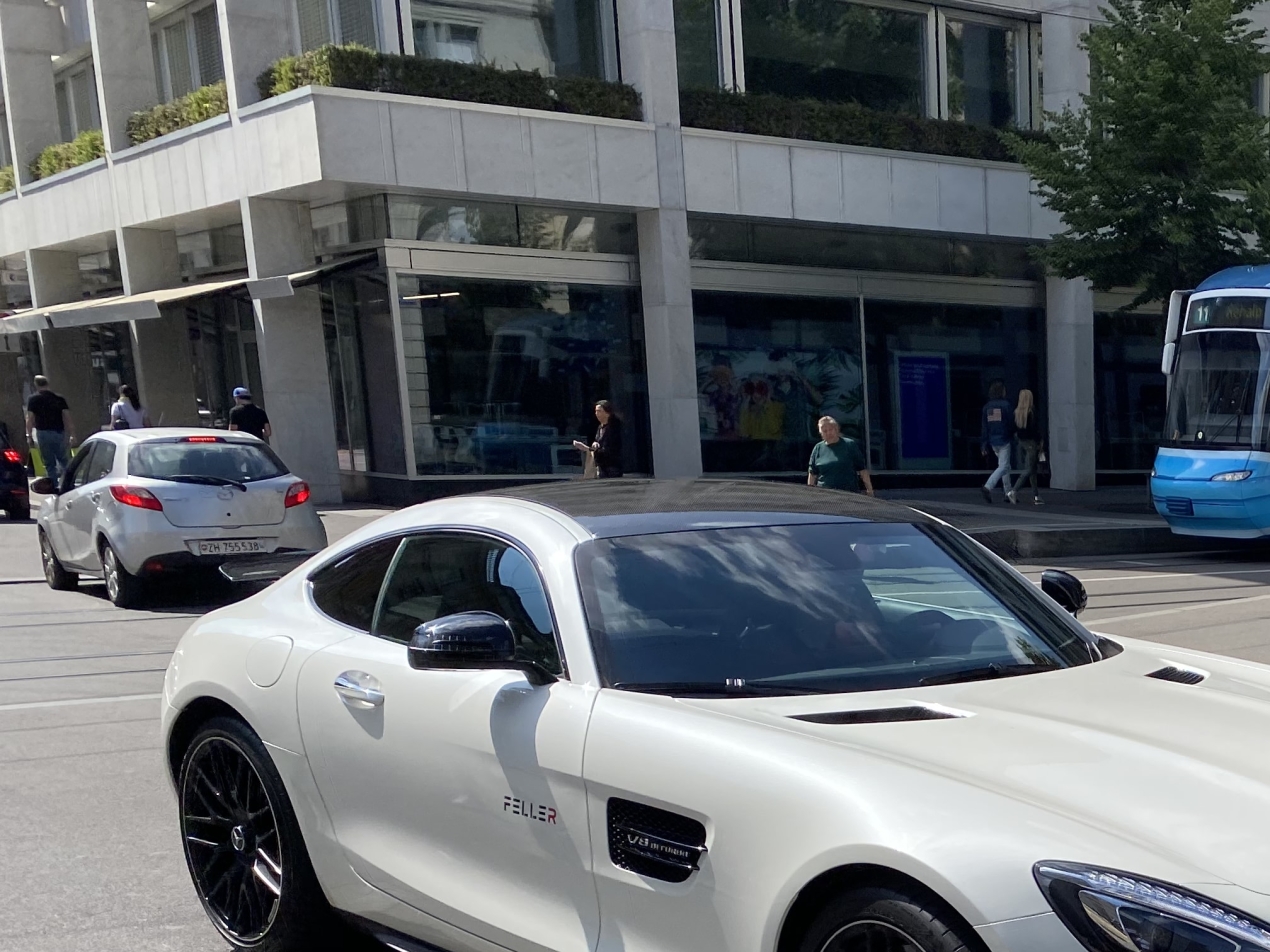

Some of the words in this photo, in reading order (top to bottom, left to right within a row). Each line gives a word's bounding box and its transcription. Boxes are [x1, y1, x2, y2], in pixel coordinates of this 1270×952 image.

[1197, 305, 1209, 321] 11
[503, 796, 557, 824] FELLER
[627, 833, 649, 847] V8
